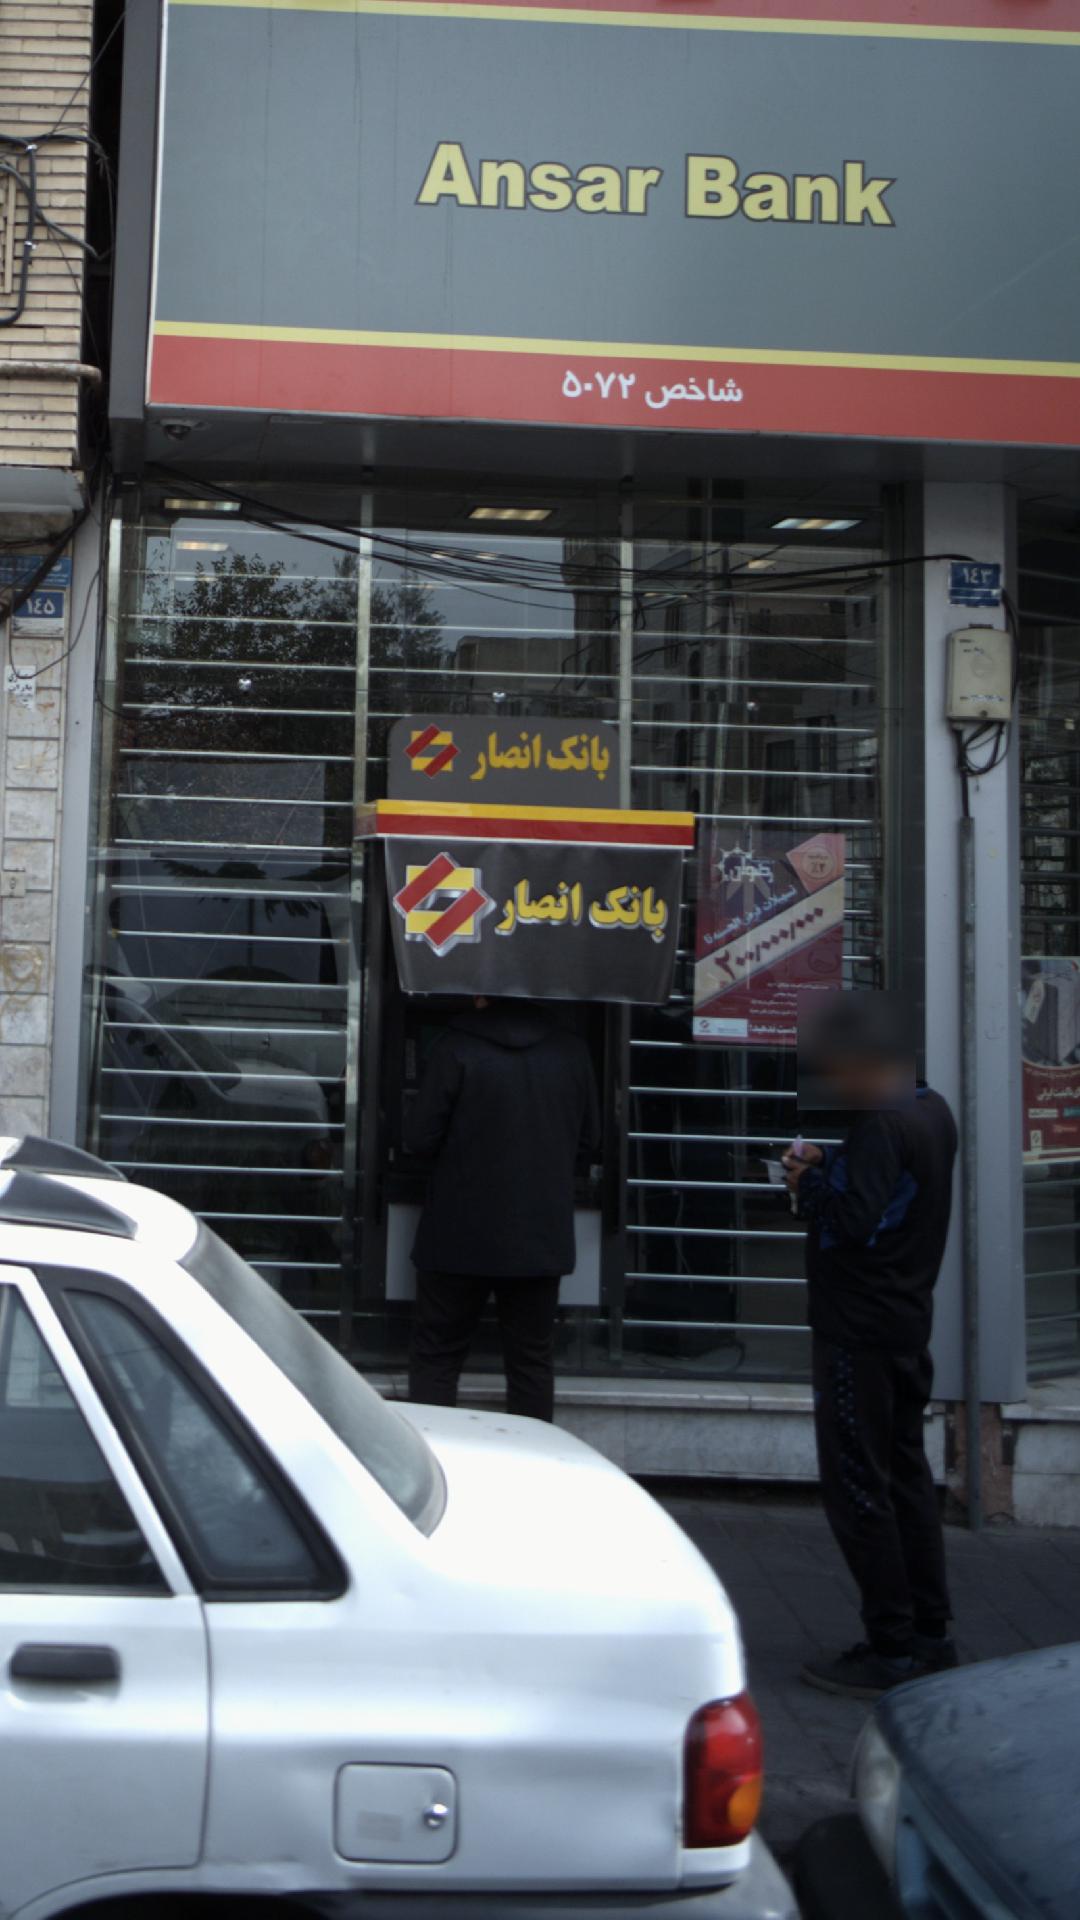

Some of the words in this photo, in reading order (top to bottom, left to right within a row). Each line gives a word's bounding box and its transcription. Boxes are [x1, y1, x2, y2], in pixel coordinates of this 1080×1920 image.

[414, 140, 664, 216] Ansar
[684, 152, 898, 227] Bank
[561, 369, 637, 400] ۵۰۷۲
[644, 376, 744, 410] شاخص
[469, 731, 542, 781] انصار
[546, 733, 610, 780] بانک
[494, 878, 585, 936] انصار
[588, 885, 670, 943] بانک
